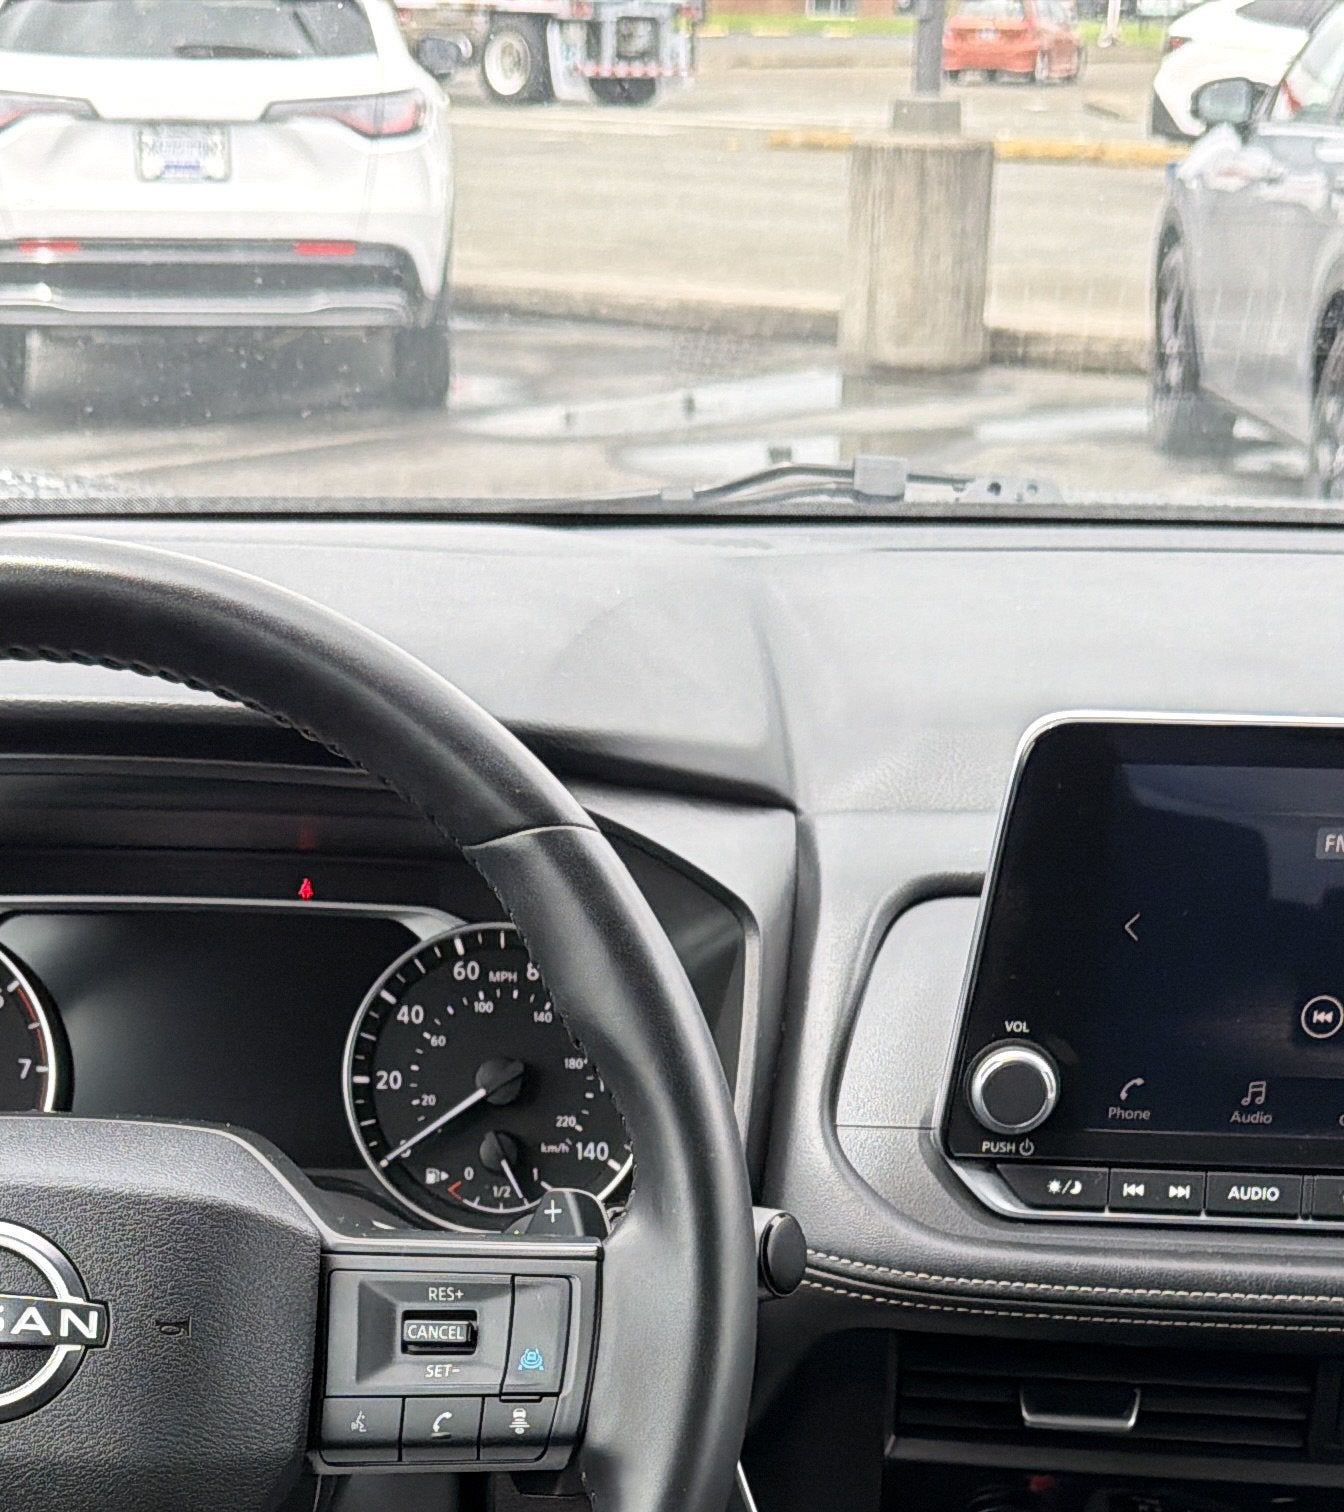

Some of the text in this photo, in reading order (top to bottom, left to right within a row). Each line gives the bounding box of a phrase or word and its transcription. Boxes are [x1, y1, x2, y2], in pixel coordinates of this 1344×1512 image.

[452, 960, 480, 981] 60
[488, 970, 518, 983] MPH
[473, 1001, 494, 1013] 100
[396, 1004, 424, 1025] 40
[533, 1011, 553, 1024] 140
[1004, 1020, 1030, 1034] VOL
[430, 1035, 447, 1047] 60
[17, 1058, 32, 1080] 7
[564, 1057, 584, 1070] 180
[375, 1070, 402, 1090] 20
[421, 1094, 437, 1106] 20
[1107, 1106, 1151, 1121] Phone
[1229, 1109, 1274, 1125] Audio
[555, 1116, 577, 1128] 220
[540, 1141, 569, 1154] km/h
[576, 1141, 609, 1161] 140
[981, 1140, 1017, 1154] PUSH
[463, 1166, 475, 1181] 0
[532, 1167, 539, 1181] 1
[492, 1186, 511, 1198] 1/2
[1227, 1185, 1281, 1202] AUDIO
[428, 1287, 465, 1301] RES+
[407, 1324, 465, 1340] CANCEL
